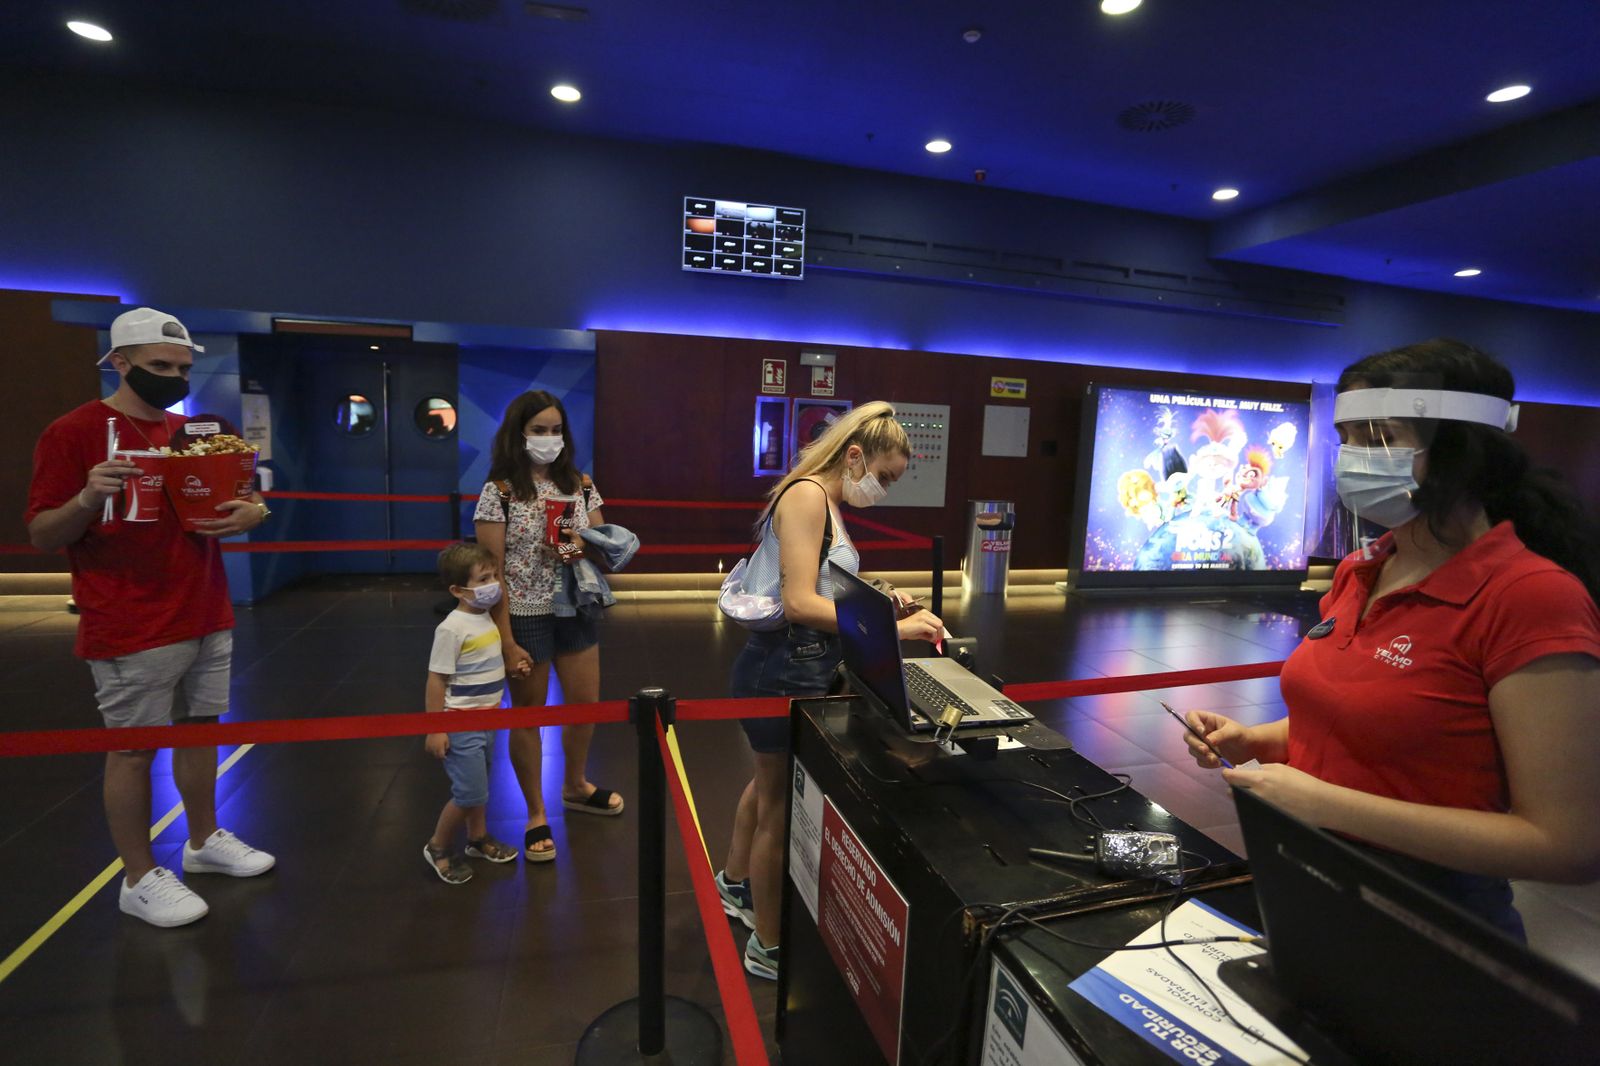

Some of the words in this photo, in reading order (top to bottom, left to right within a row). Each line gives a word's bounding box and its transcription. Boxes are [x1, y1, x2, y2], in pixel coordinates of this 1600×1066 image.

[1150, 394, 1170, 404] UNA
[1171, 395, 1211, 407] PELÍCULA
[1213, 399, 1237, 409] FELIZ.
[1239, 401, 1259, 410] MUY
[1260, 402, 1284, 412] FELIZ.
[1222, 528, 1233, 549] 2
[1376, 647, 1412, 666] YELMO
[842, 829, 876, 887] RESERVADO
[825, 826, 831, 845] EL
[832, 836, 856, 881] DERECHO
[857, 873, 865, 896] DE
[866, 887, 900, 947] ADMISIÓN
[1146, 967, 1208, 1006] ENTRADAS
[1167, 986, 1222, 1023] CONTROL
[1119, 993, 1222, 1061] SEGURIDAD
[1143, 1022, 1169, 1041] TU
[1170, 1038, 1214, 1066] POR
